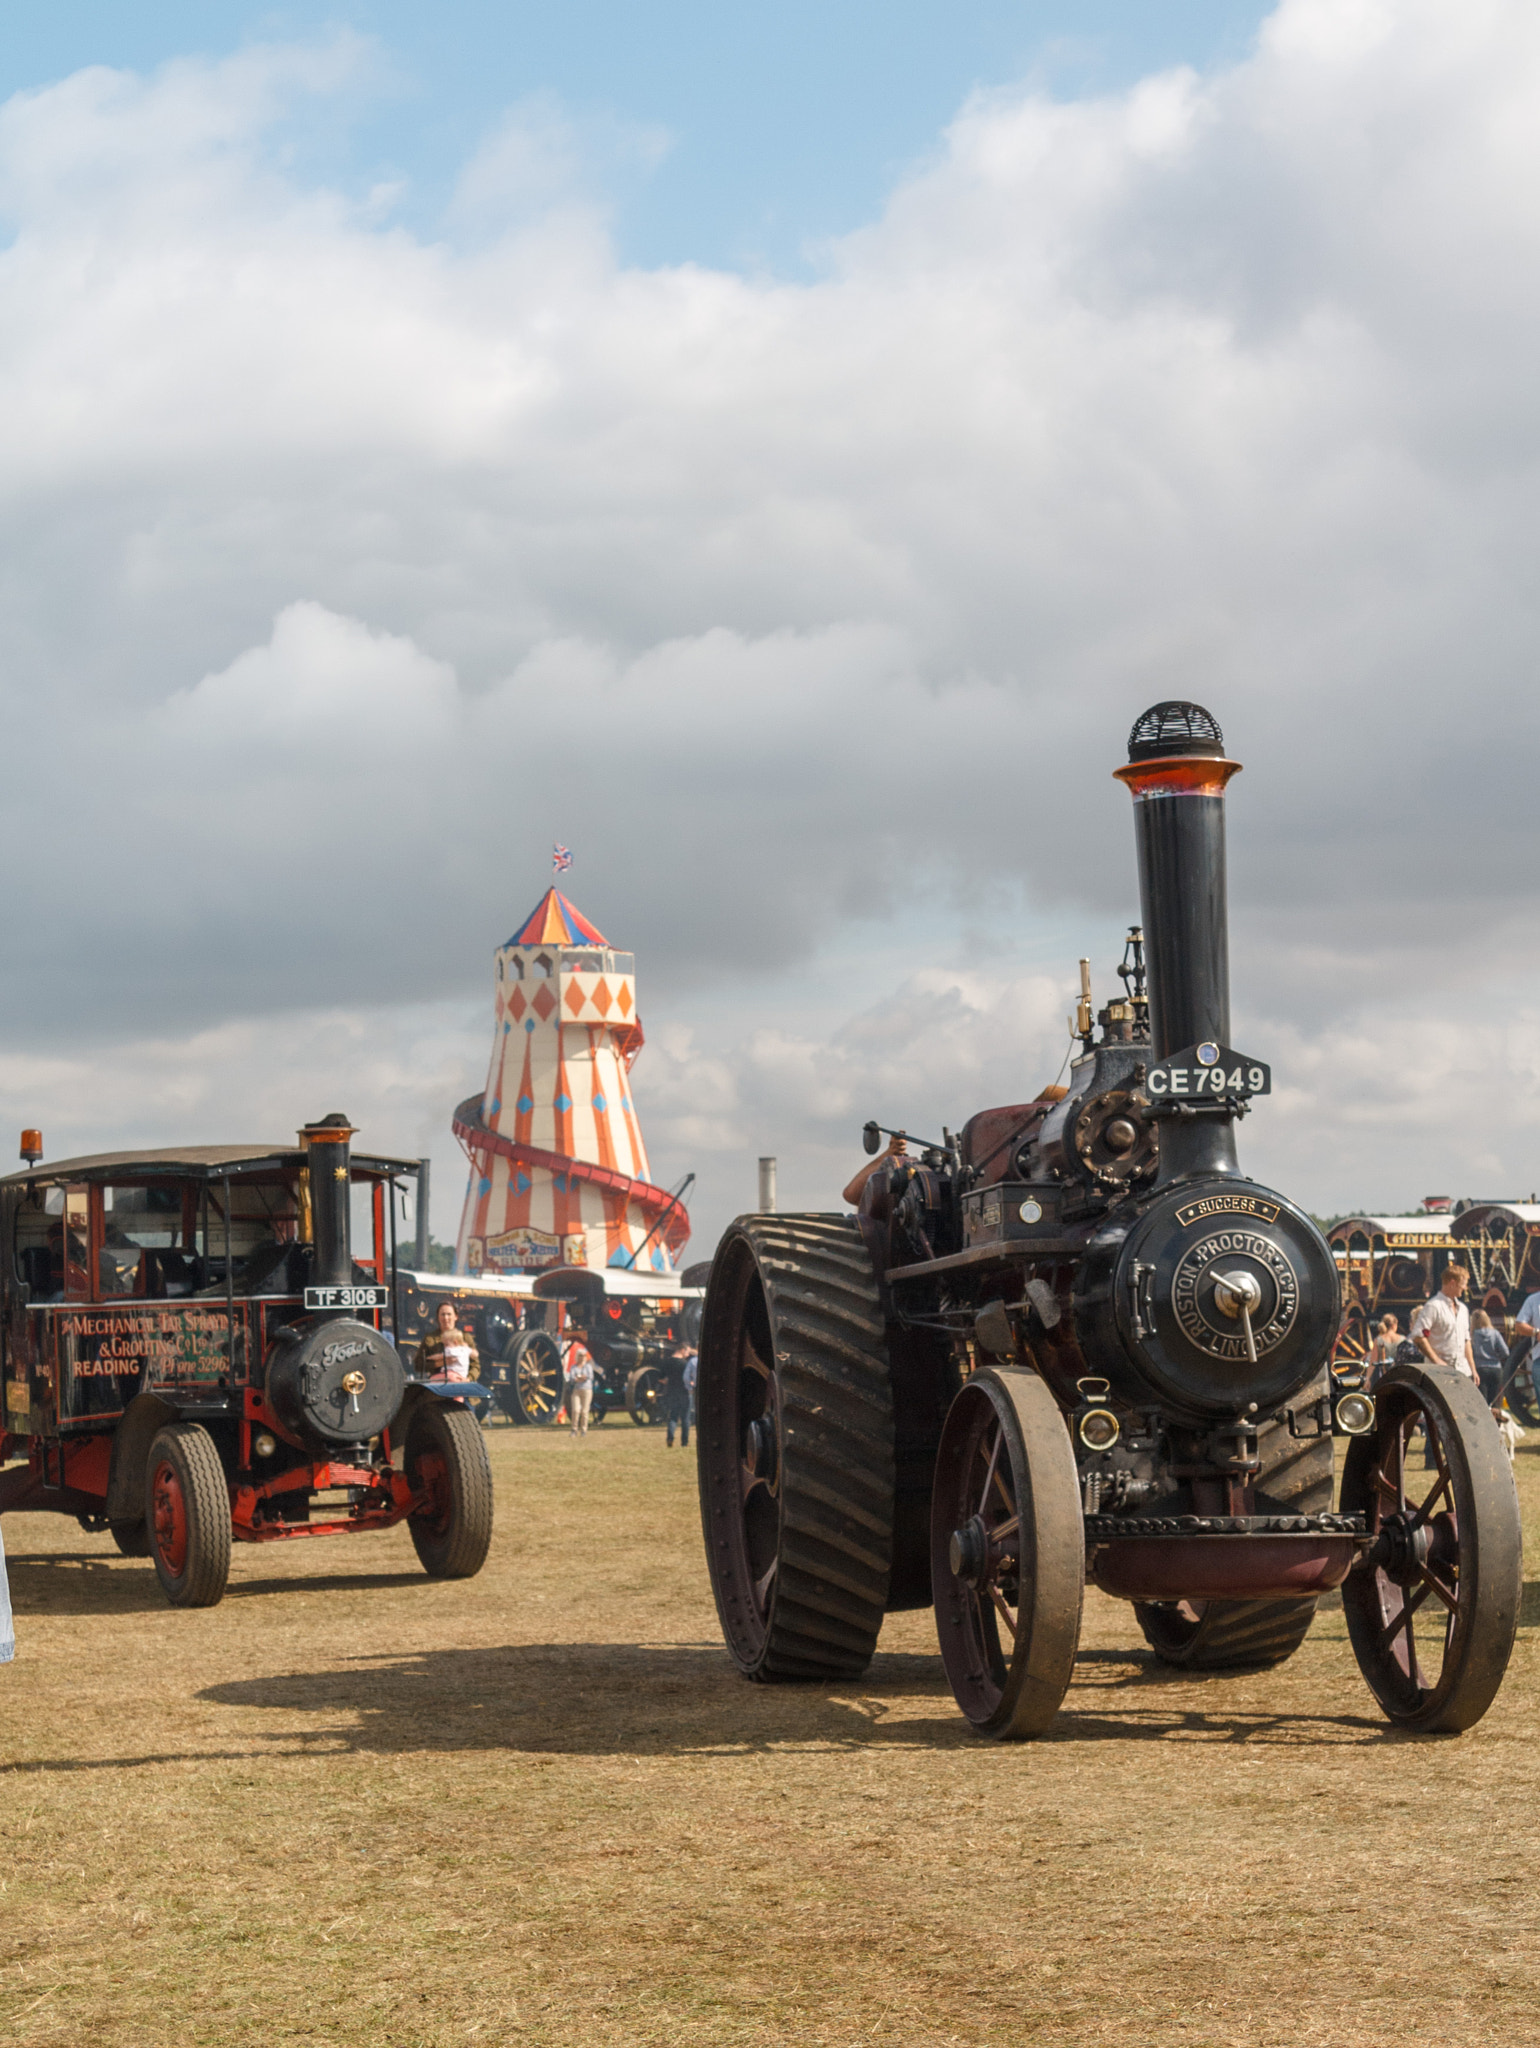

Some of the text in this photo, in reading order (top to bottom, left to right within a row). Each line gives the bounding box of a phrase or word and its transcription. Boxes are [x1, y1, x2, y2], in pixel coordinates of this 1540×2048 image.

[1147, 1066, 1265, 1094] CE 7949
[1198, 1197, 1256, 1214] SUCCESS
[1196, 1233, 1277, 1264] PROCTOR
[315, 1289, 377, 1306] TF 3106
[73, 1315, 156, 1336] MECHANICAL
[159, 1312, 182, 1333] TAR
[99, 1341, 111, 1358] &
[111, 1336, 174, 1357] GROUTING
[1208, 1319, 1285, 1356] LINCOLN
[322, 1339, 378, 1367] Foden
[73, 1359, 140, 1378] READING
